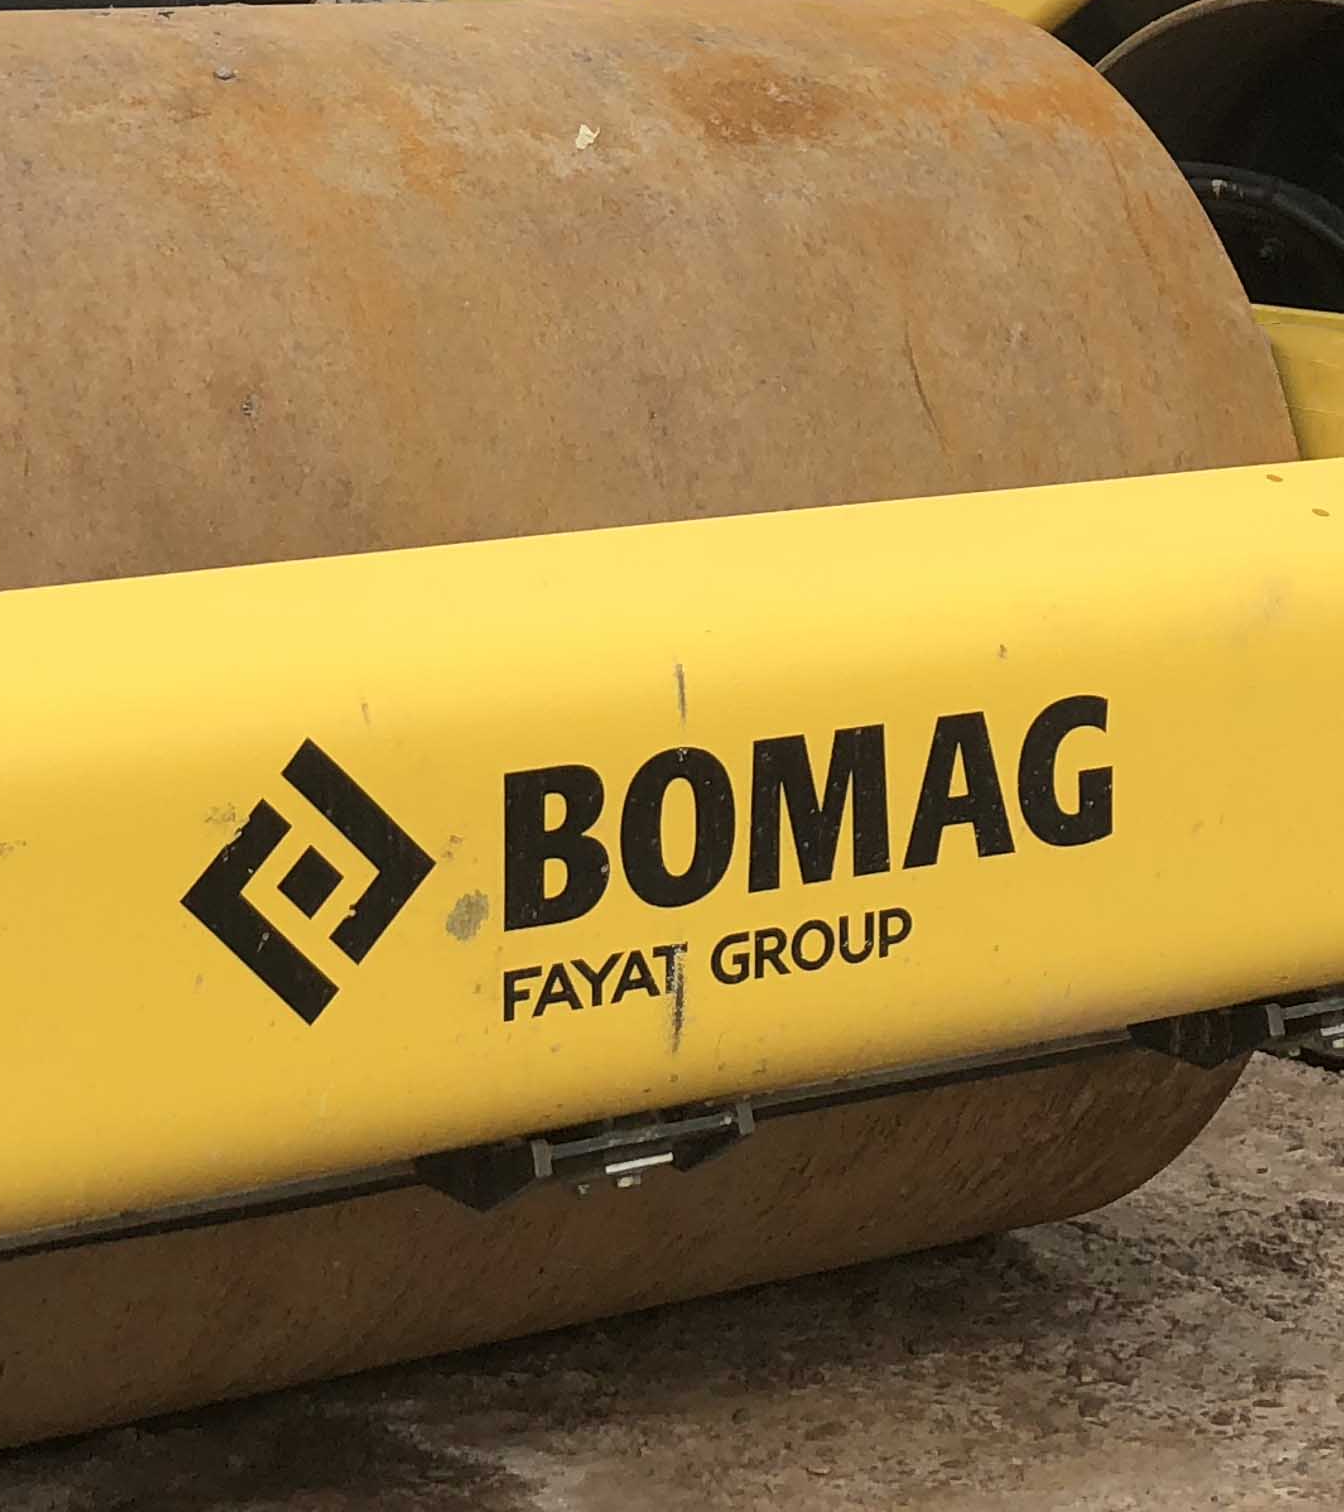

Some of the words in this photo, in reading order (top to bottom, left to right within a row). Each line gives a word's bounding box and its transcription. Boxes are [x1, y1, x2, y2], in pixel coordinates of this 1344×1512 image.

[503, 694, 1114, 932] BOMAG
[503, 941, 689, 1023] FAYAT
[710, 907, 913, 985] GROUP
